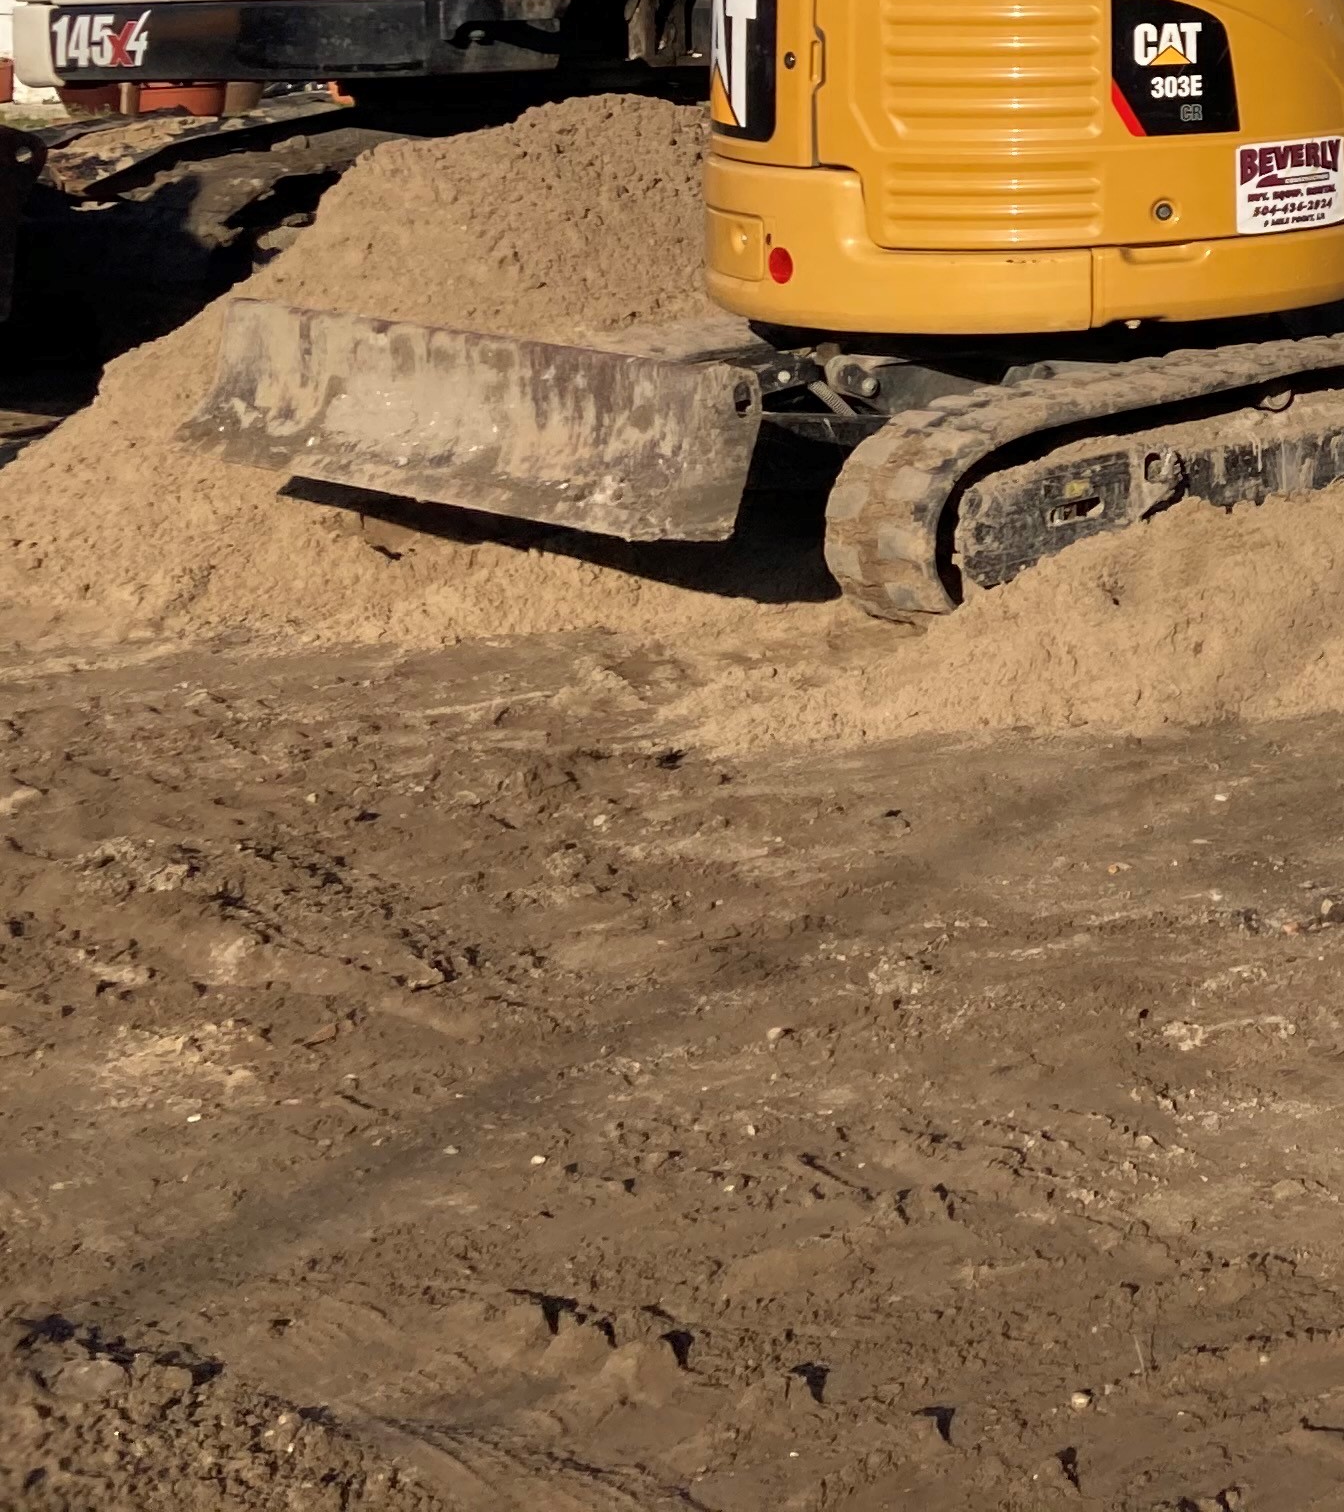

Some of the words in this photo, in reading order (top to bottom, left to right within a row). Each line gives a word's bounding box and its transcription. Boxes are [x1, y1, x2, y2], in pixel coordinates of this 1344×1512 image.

[1133, 22, 1202, 66] CAT
[1151, 74, 1203, 98] 303E
[1180, 104, 1203, 122] CR
[1240, 138, 1341, 186] BEVERLY
